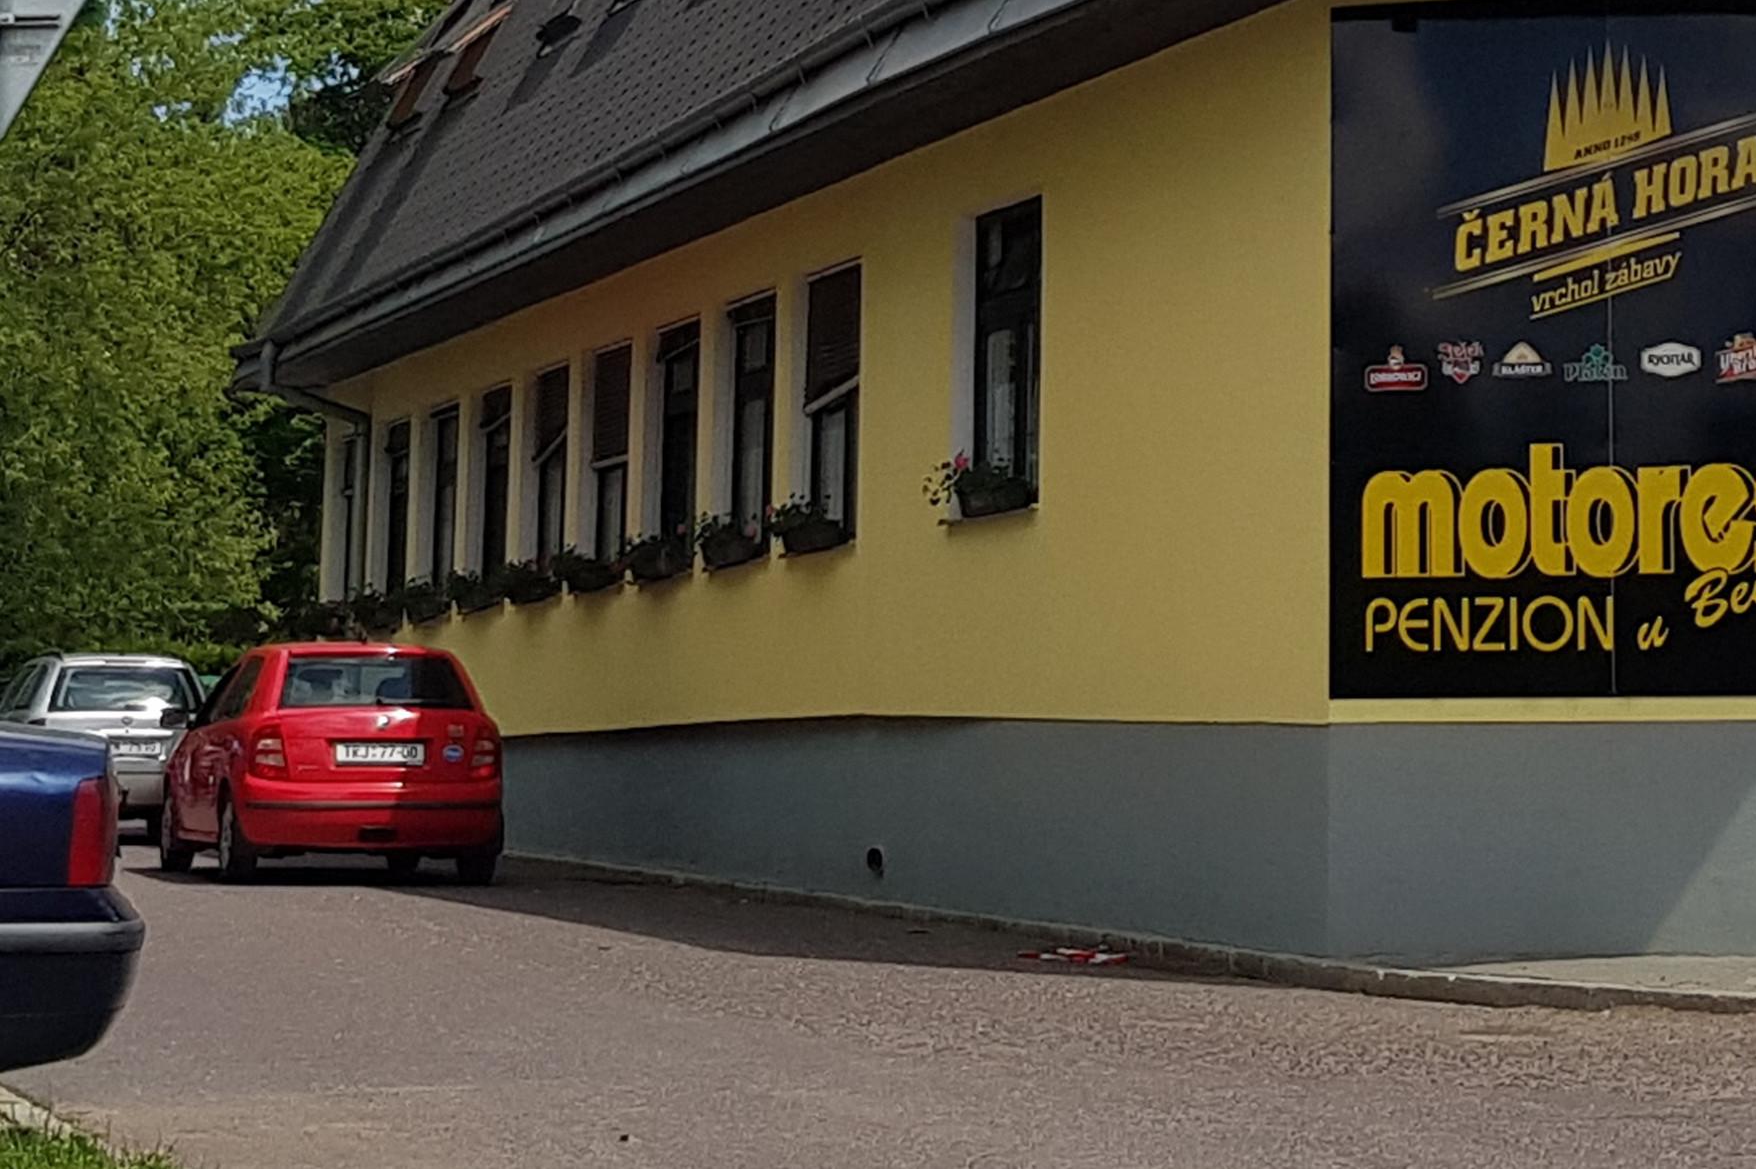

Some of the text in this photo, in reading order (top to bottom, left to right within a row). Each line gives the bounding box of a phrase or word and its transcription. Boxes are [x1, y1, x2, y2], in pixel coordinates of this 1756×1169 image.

[1574, 140, 1611, 160] ANNO
[1454, 171, 1619, 272] ČERNÁ
[1530, 251, 1683, 312] vrchol zábavy
[1365, 595, 1615, 652] PENZION
[1636, 615, 1670, 651] u
